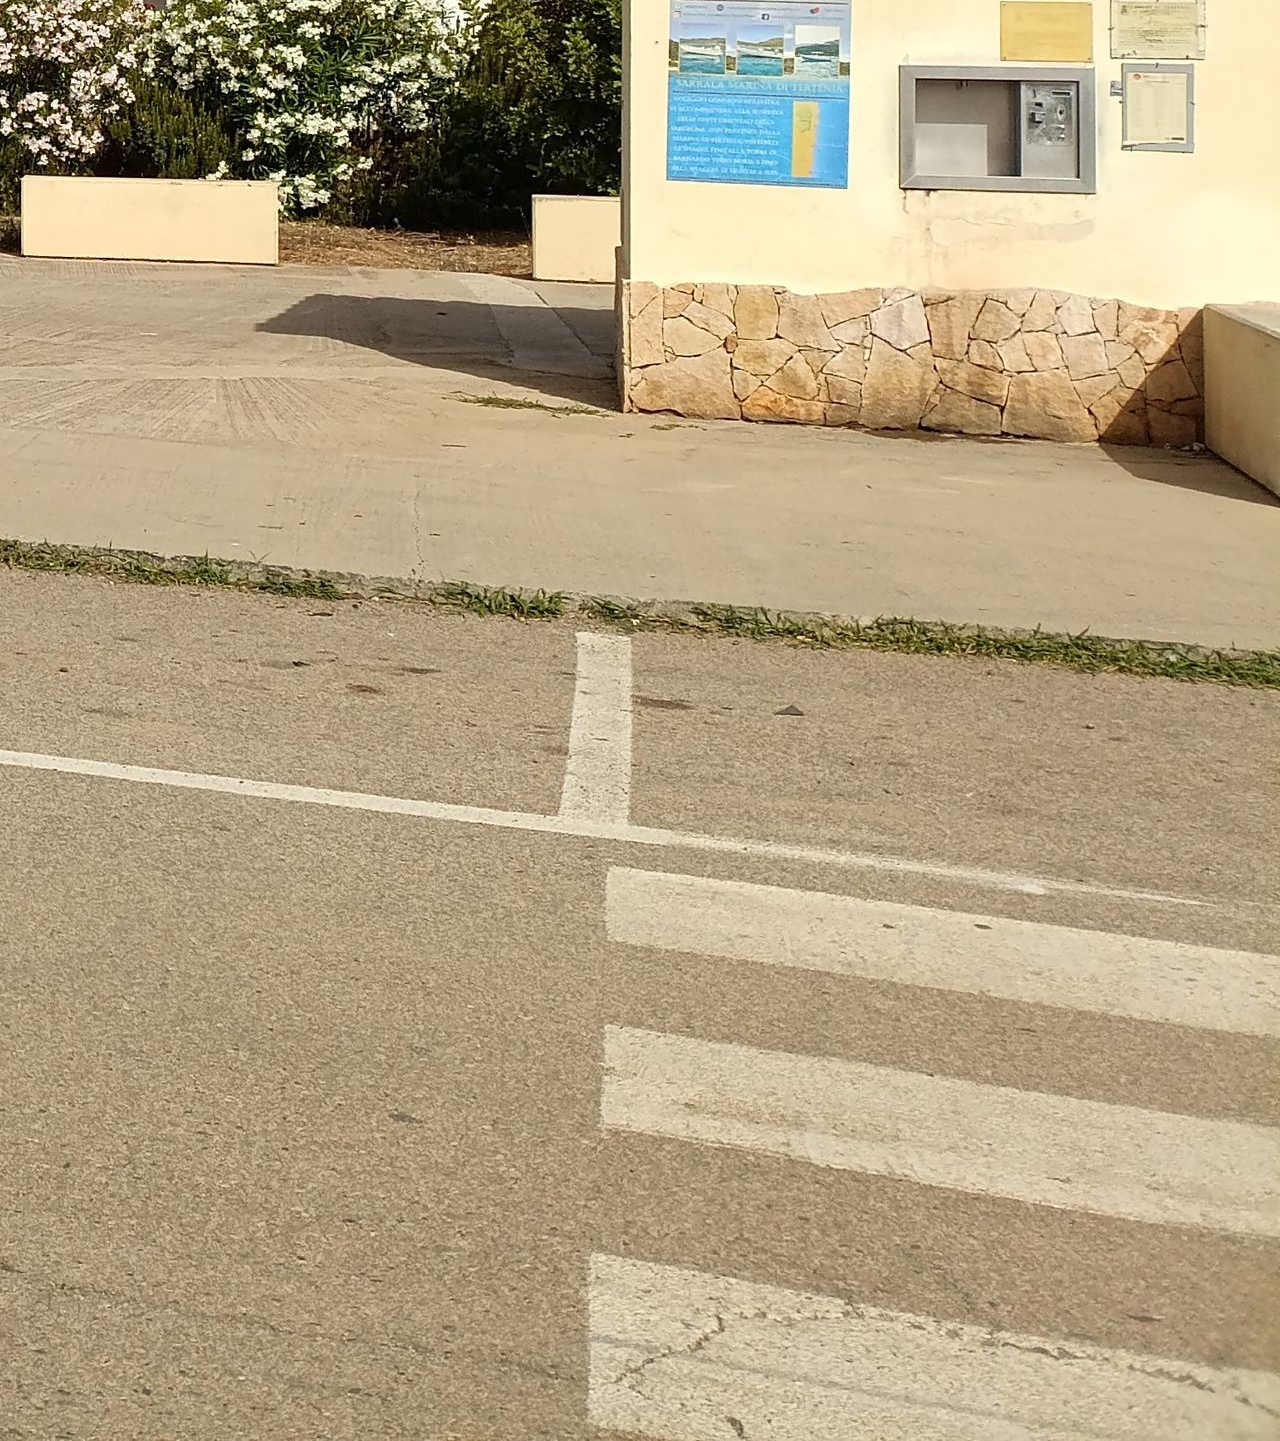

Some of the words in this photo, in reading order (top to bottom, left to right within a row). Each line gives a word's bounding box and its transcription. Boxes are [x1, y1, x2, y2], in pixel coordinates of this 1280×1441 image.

[728, 81, 772, 90] MARINA
[776, 82, 788, 91] DI
[792, 83, 844, 93] TERTENIA
